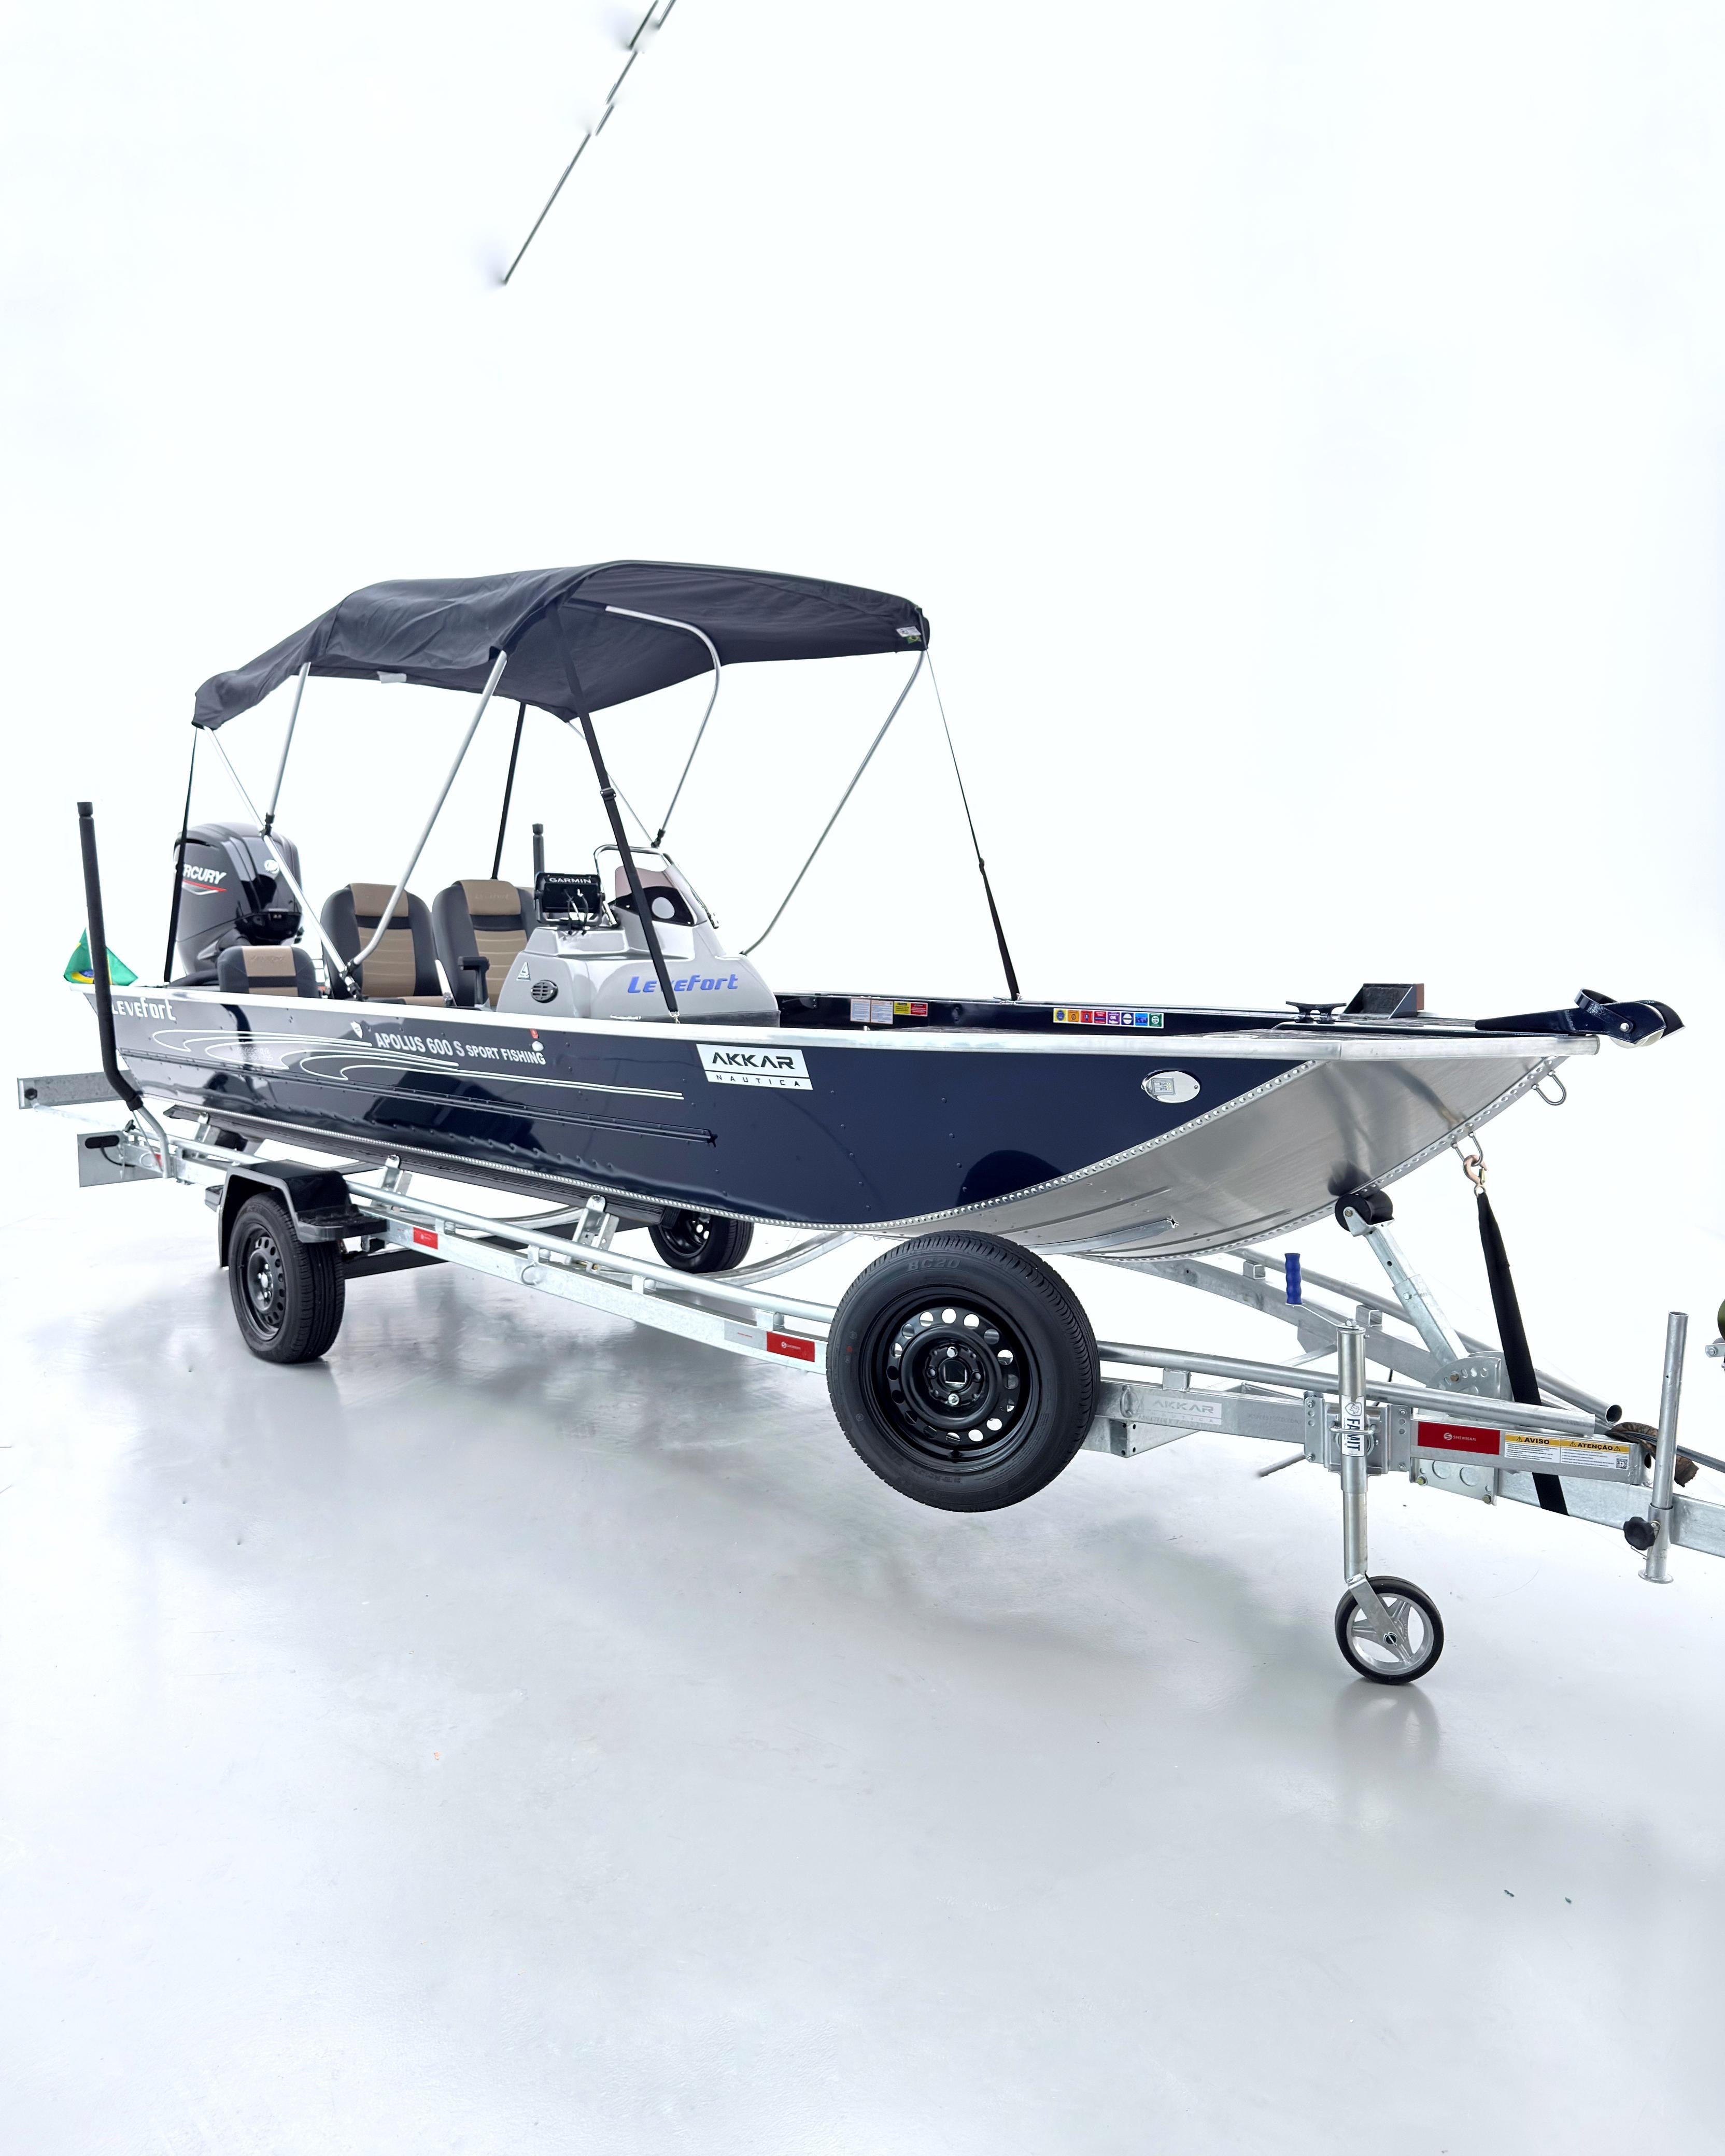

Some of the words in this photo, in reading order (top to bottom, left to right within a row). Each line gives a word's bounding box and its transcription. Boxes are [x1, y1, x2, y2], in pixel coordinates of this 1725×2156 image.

[182, 863, 227, 884] RCURY
[375, 1032, 426, 1053] APOLUS
[426, 1037, 453, 1056] 600
[454, 1041, 465, 1057] S
[466, 1044, 500, 1060] SPORT
[500, 1048, 546, 1066] FISHING
[712, 1052, 796, 1070] AKKAR
[716, 1074, 801, 1087] NAUTICA
[908, 1258, 961, 1270] BC20
[1152, 1400, 1213, 1413] AKKAR
